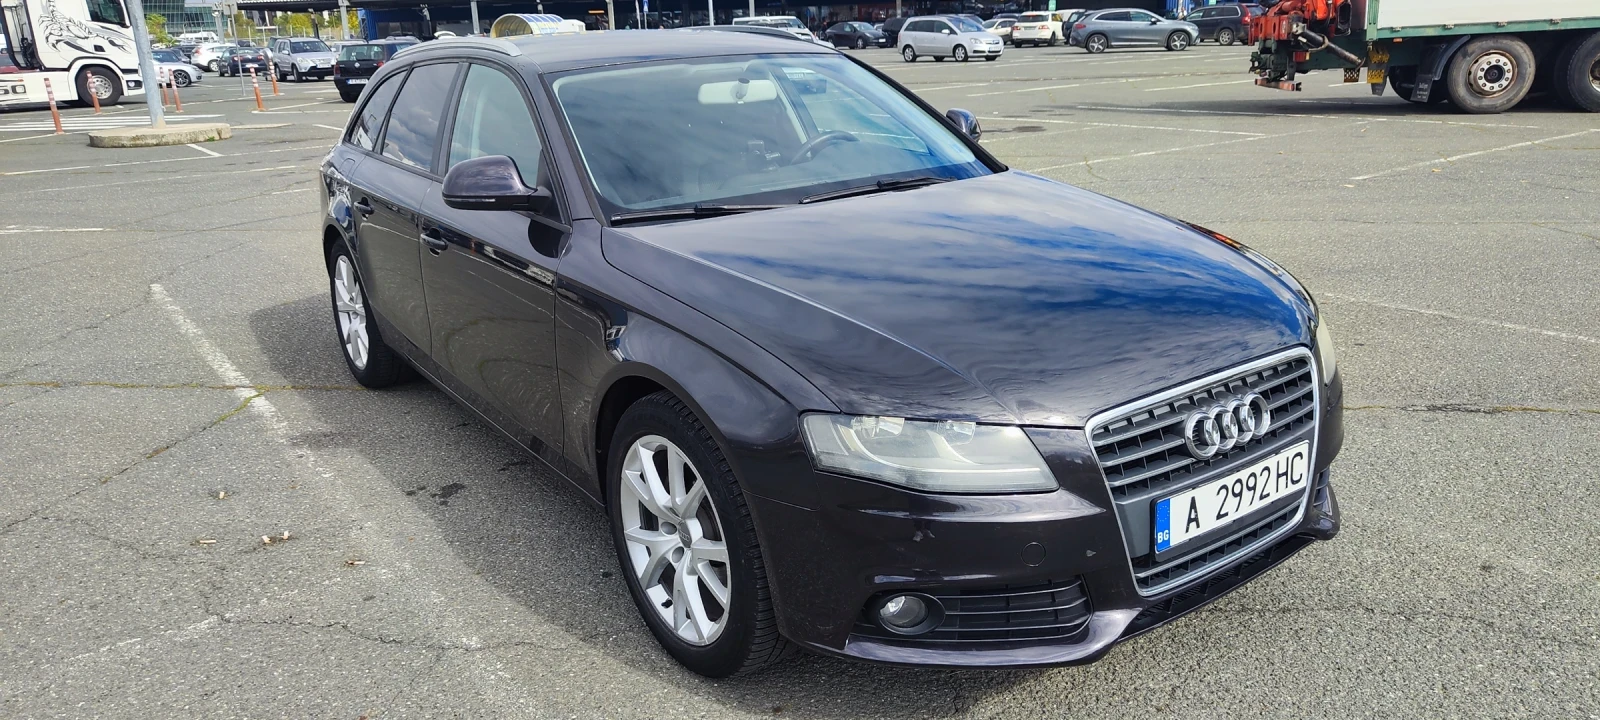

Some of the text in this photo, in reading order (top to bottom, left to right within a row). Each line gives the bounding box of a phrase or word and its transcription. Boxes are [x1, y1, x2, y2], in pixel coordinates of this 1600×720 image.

[1185, 451, 1304, 534] A 2992 HC
[1157, 530, 1170, 544] BG
